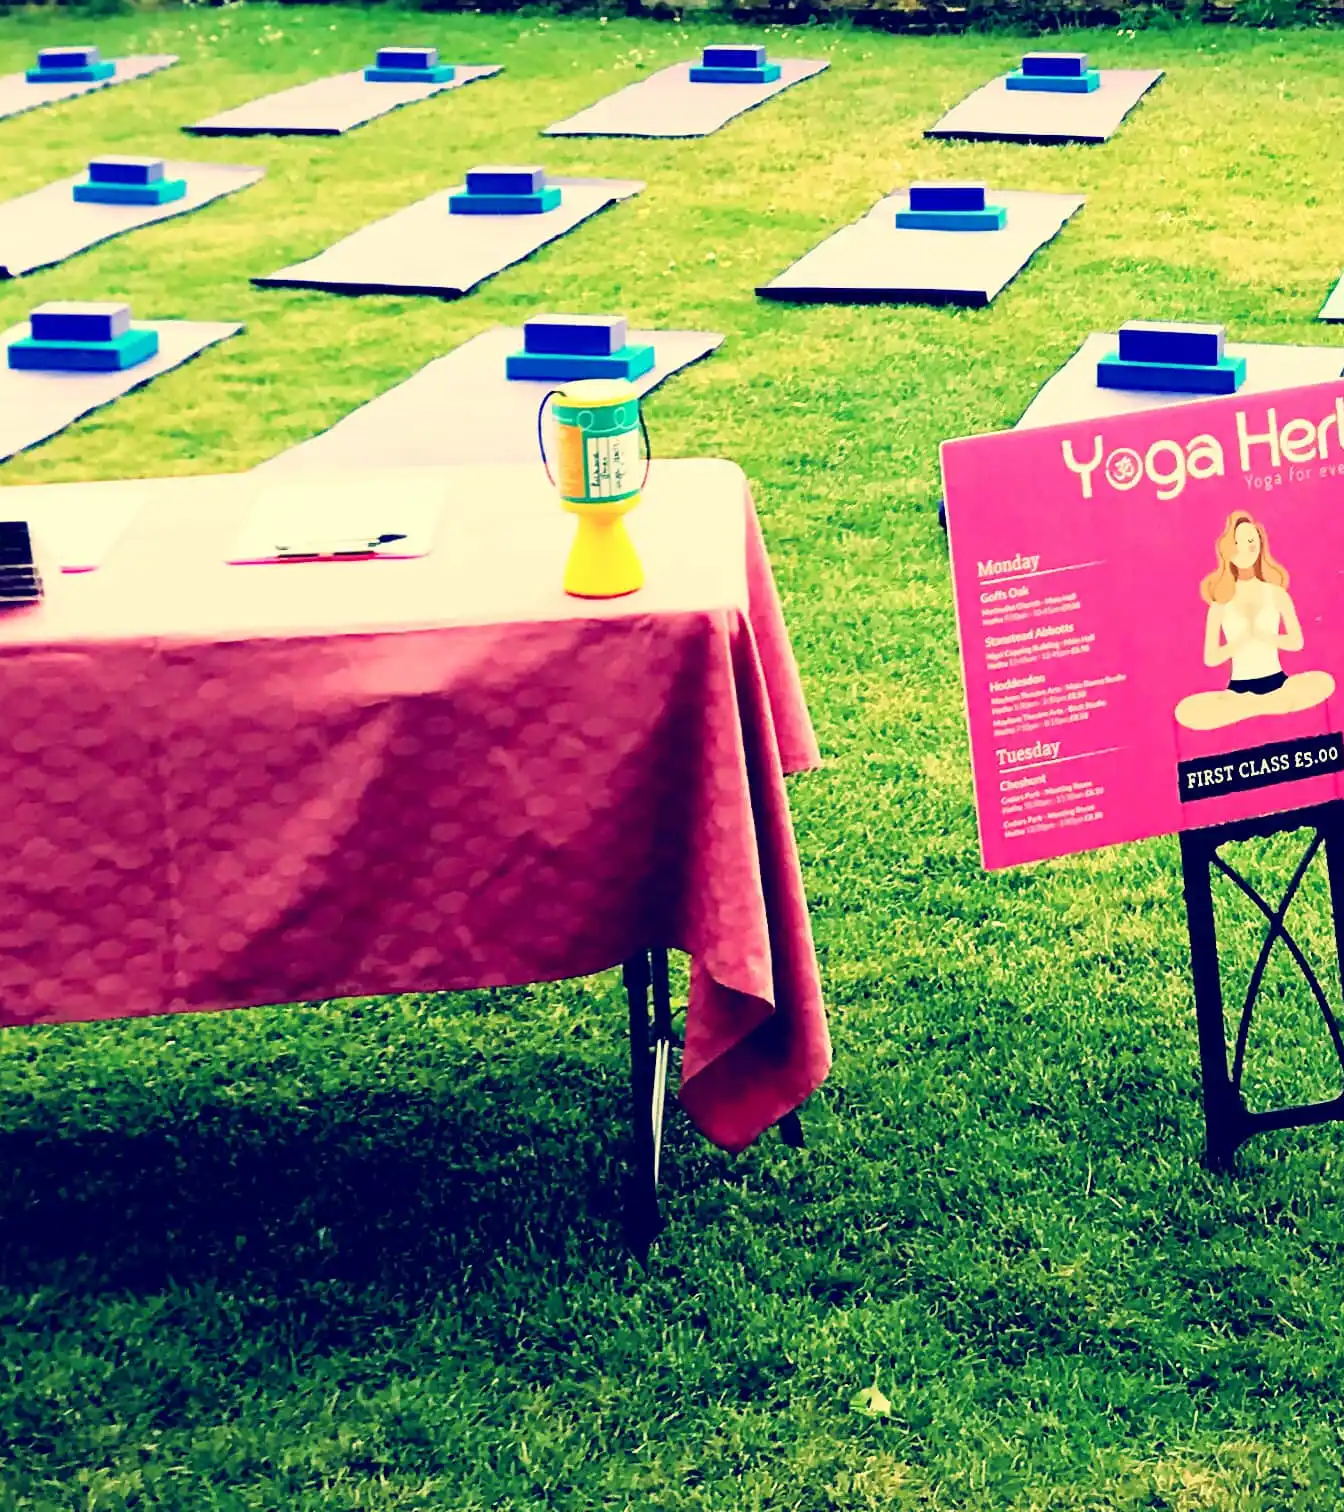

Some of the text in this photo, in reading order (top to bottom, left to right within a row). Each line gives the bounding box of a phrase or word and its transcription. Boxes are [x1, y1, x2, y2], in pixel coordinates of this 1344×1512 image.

[1062, 434, 1225, 500] Yoga
[1244, 472, 1282, 491] Yoga
[1289, 466, 1311, 482] for
[977, 552, 1041, 578] Monday
[996, 740, 1061, 765] Tuesday
[1187, 746, 1339, 789] FIRST CLASS £5.00
